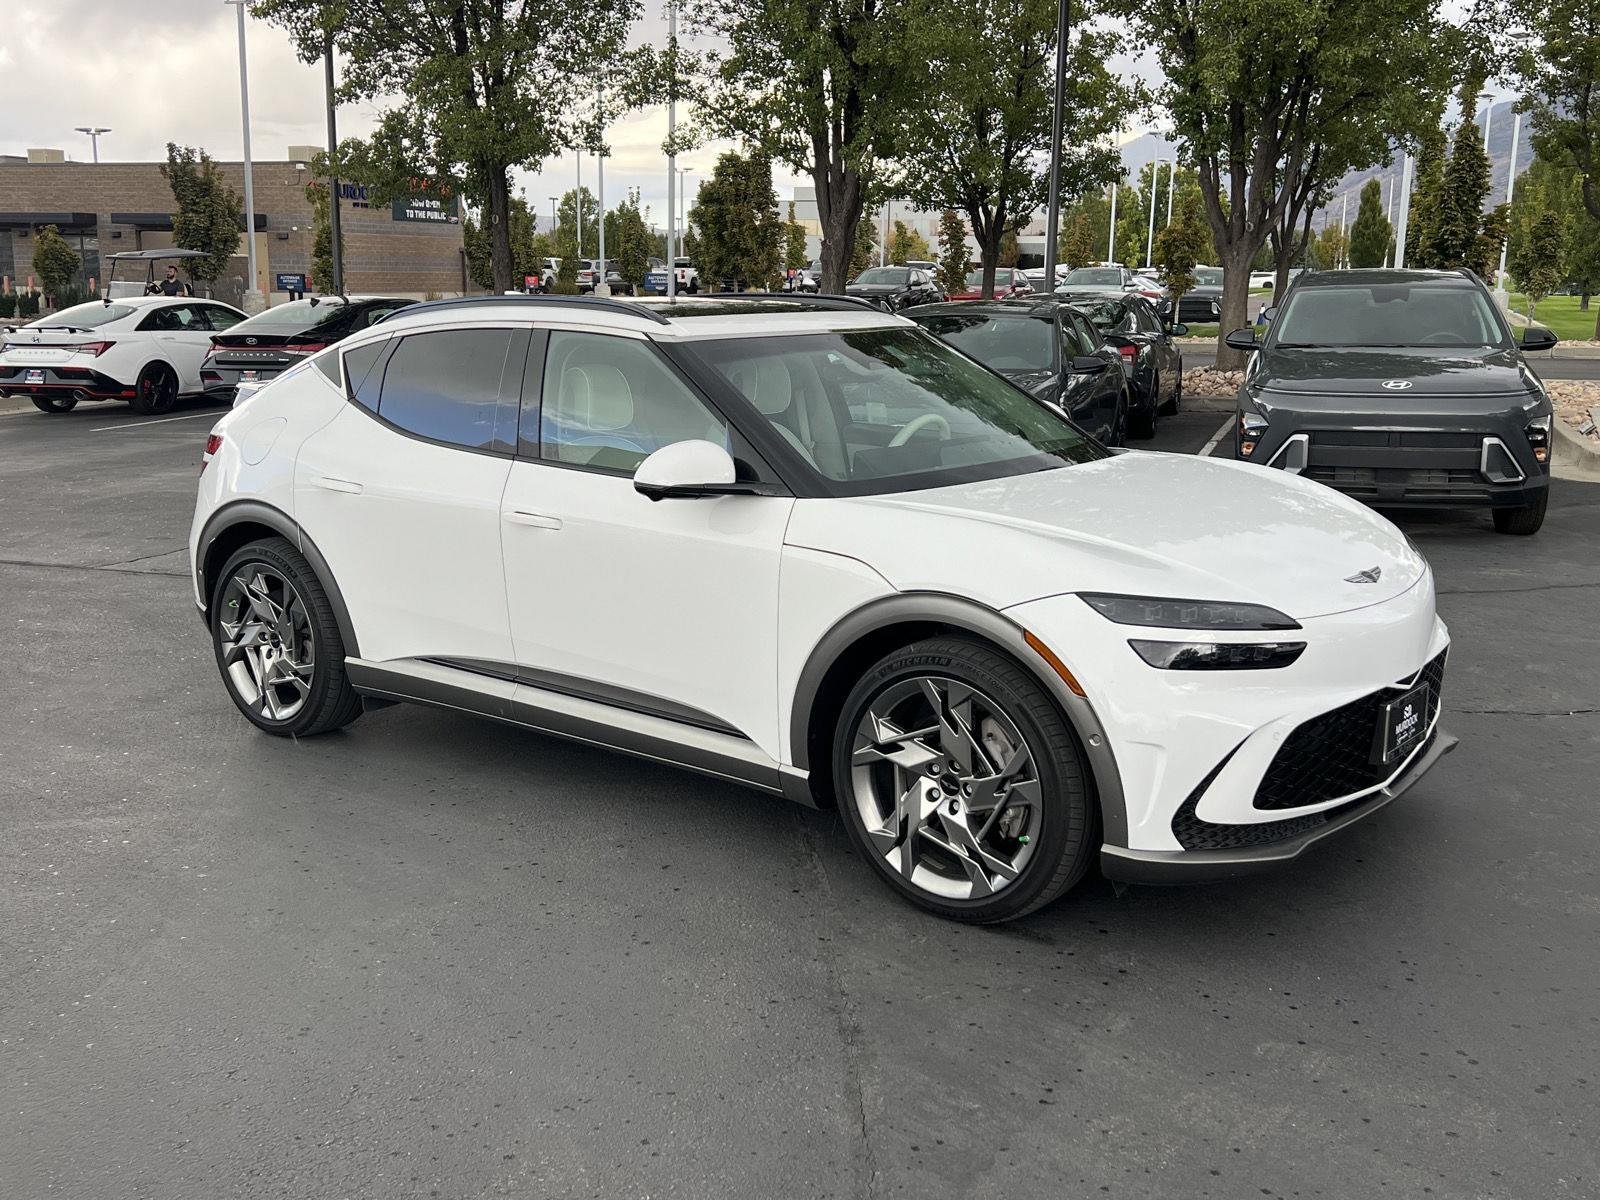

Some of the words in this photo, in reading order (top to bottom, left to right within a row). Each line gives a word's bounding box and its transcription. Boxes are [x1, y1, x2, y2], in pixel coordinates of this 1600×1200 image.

[405, 209, 414, 218] TO
[414, 210, 426, 219] THE
[426, 211, 447, 220] PUBLIC
[892, 656, 950, 669] MICHELIN
[1395, 712, 1419, 735] MURDOCK
